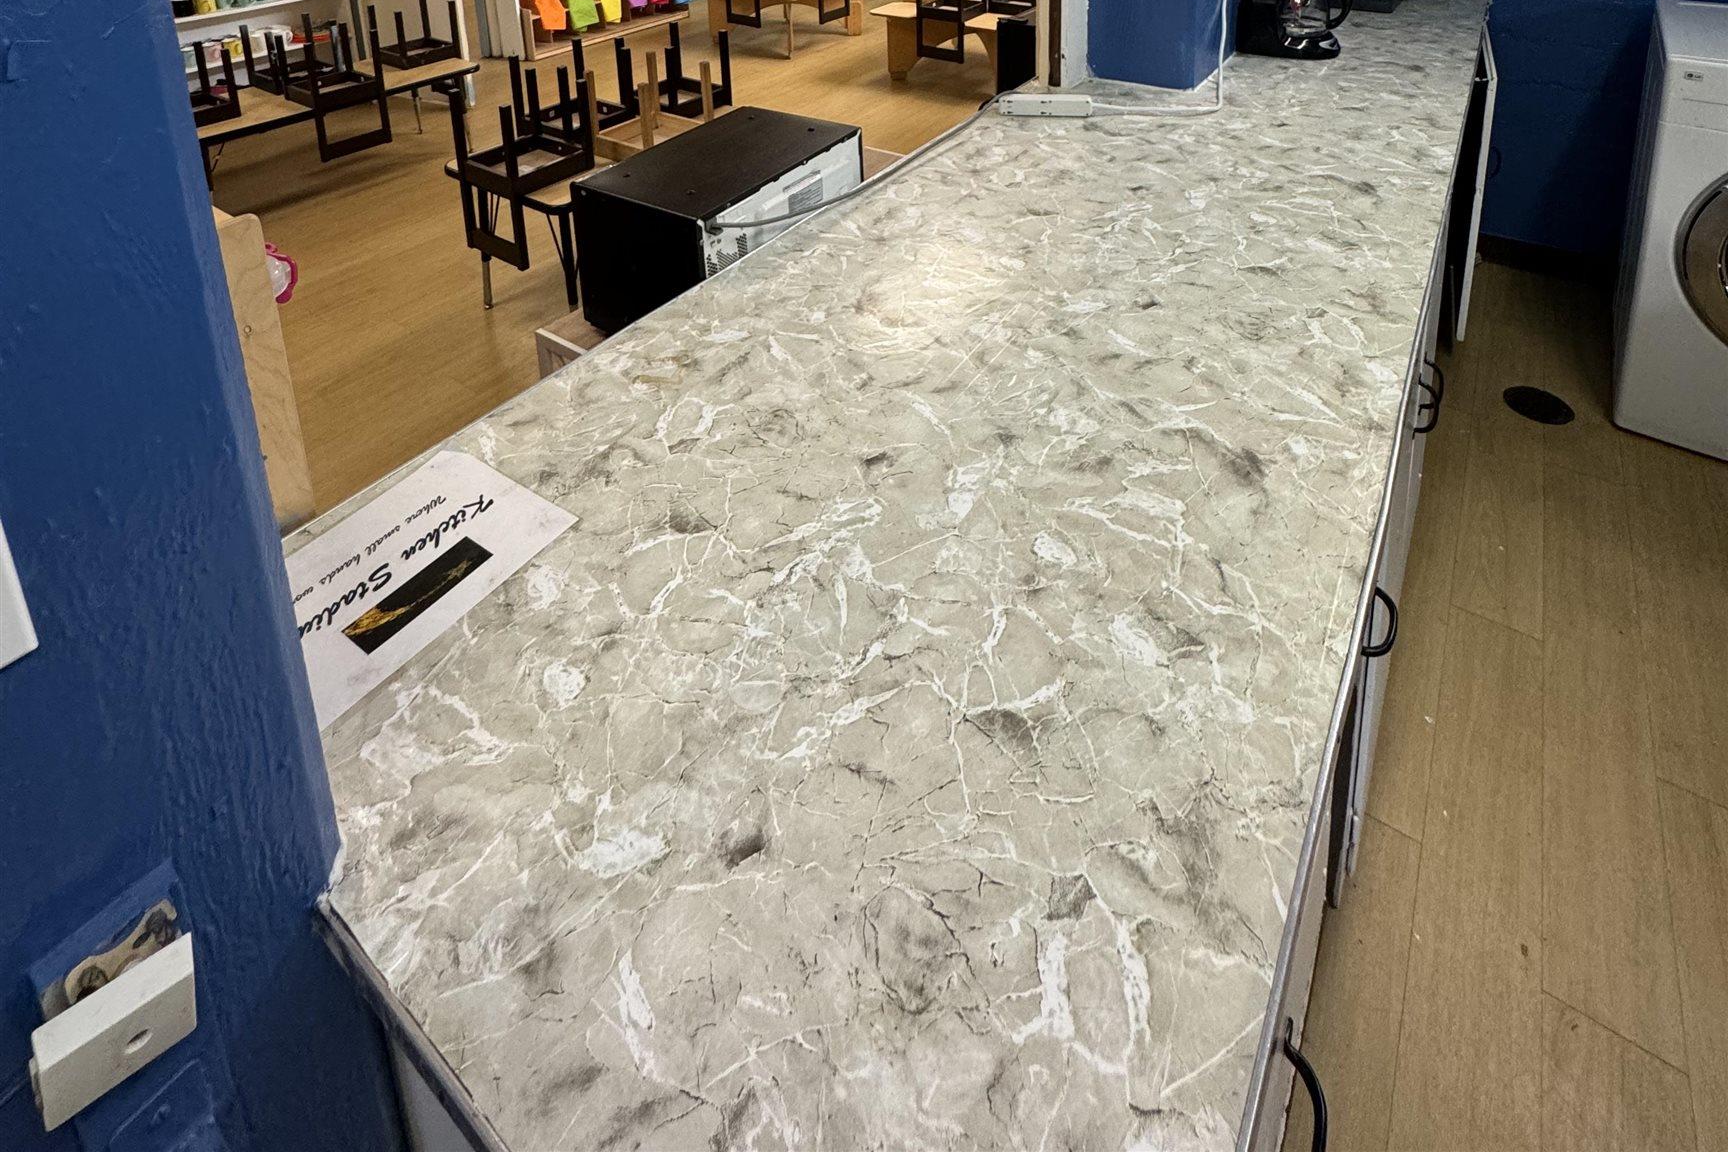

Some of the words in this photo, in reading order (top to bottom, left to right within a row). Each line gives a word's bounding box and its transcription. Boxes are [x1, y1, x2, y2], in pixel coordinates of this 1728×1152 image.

[405, 495, 446, 524] Where
[364, 525, 401, 556] small
[401, 494, 494, 561] Kitchen
[319, 555, 361, 585] hands
[298, 562, 392, 639] Stadiu
